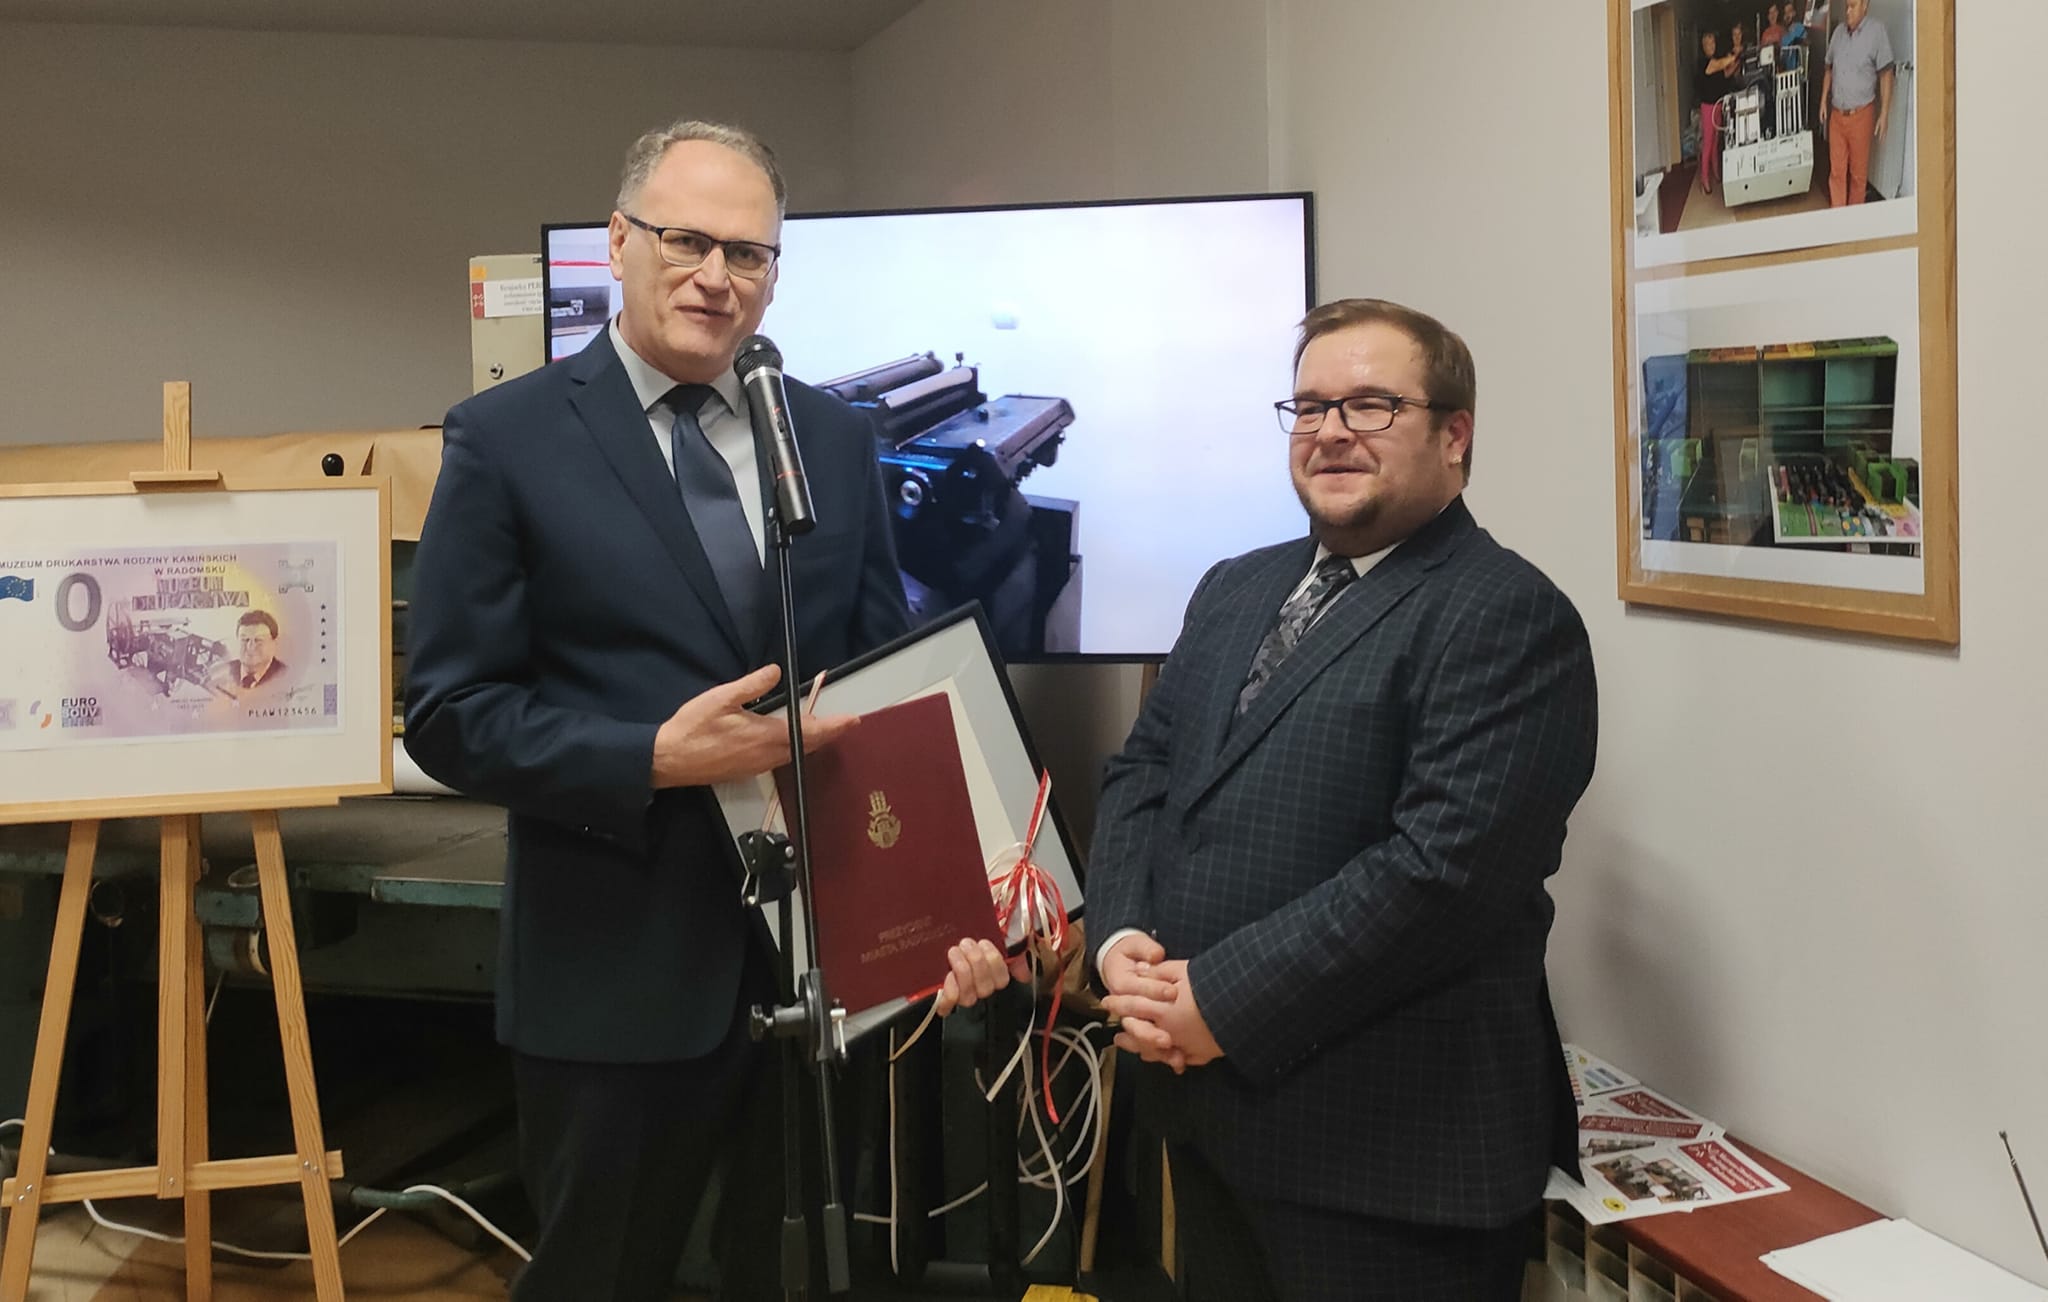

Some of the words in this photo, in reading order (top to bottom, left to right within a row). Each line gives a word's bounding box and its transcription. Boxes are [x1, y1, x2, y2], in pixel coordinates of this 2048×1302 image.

[0, 560, 42, 569] MUZEUM
[46, 558, 120, 569] DRUKARSTWA
[123, 555, 169, 565] RODZINY
[154, 567, 163, 575] W
[166, 565, 226, 575] RADOMSKU
[55, 572, 102, 632] 0
[61, 697, 97, 707] EURO
[61, 707, 97, 718] SOUV
